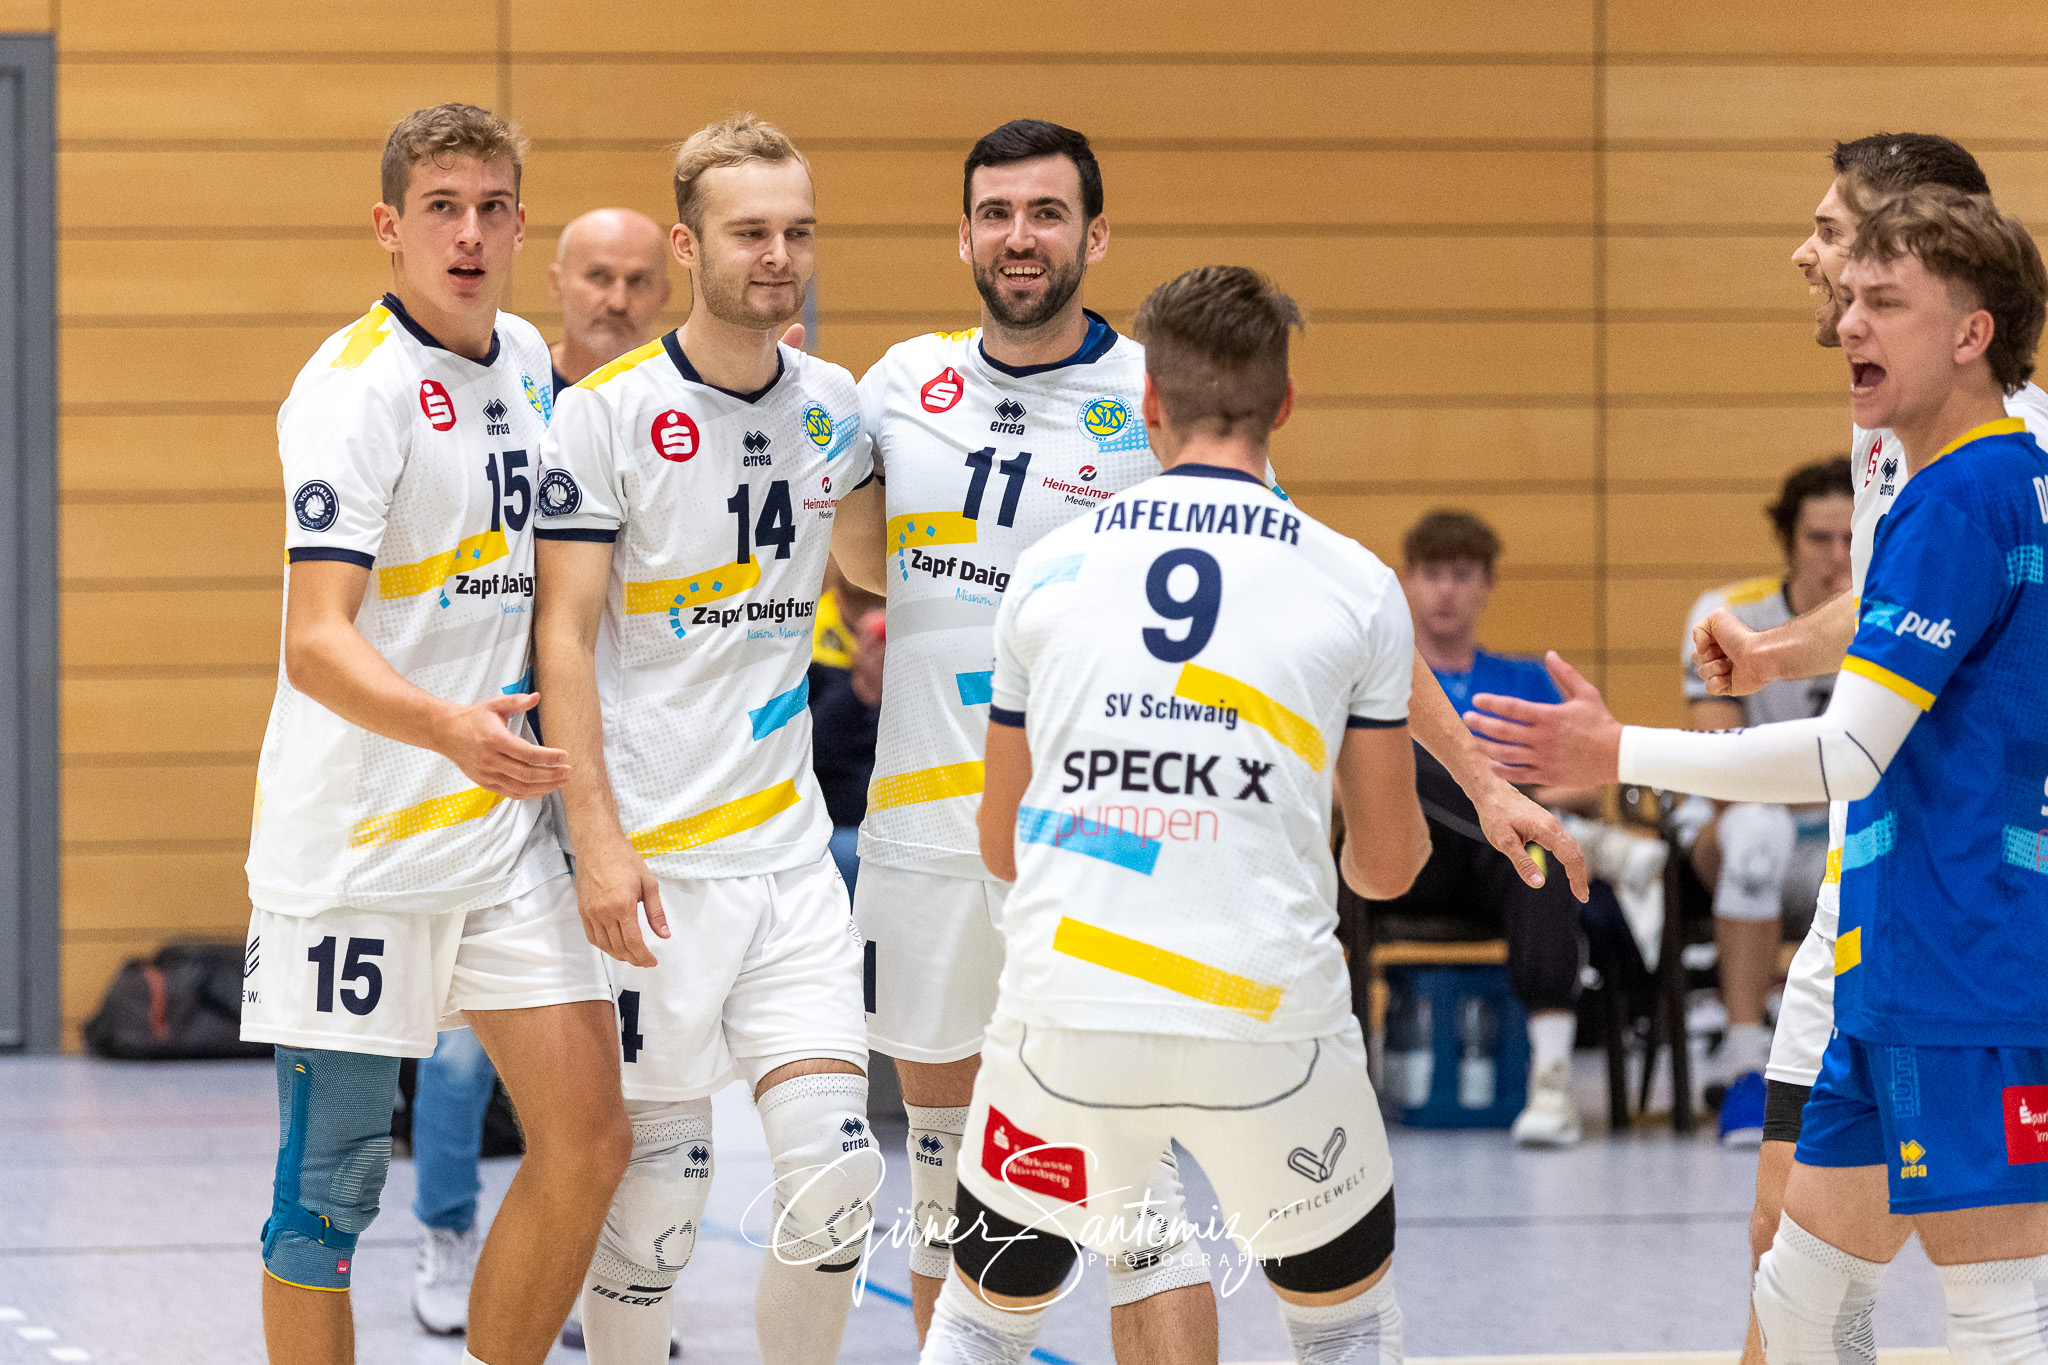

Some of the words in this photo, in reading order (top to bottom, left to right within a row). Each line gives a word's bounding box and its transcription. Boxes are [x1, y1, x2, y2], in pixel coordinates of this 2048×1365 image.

[487, 423, 510, 436] errea
[990, 421, 1025, 436] errea
[744, 454, 772, 467] errea
[485, 449, 531, 532] 15
[963, 447, 1032, 528] 11
[1064, 495, 1096, 508] Medien
[727, 480, 795, 564] 14
[1092, 500, 1302, 546] TAFELMAYER
[456, 574, 500, 599] Zapf
[501, 572, 536, 598] Daig
[911, 548, 958, 578] Zapf
[959, 561, 1011, 593] Daig
[691, 603, 745, 628] Zapf
[1142, 547, 1223, 664] 9
[1895, 611, 1956, 649] puls
[1105, 694, 1132, 718] SV
[1140, 694, 1239, 731] Schwaig
[1062, 750, 1222, 797] SPECK
[1055, 805, 1219, 849] pumpen
[307, 935, 385, 1015] 15
[617, 988, 643, 1064] 4
[842, 1137, 870, 1153] errea
[916, 1151, 943, 1167] errea
[684, 1167, 709, 1178] errea
